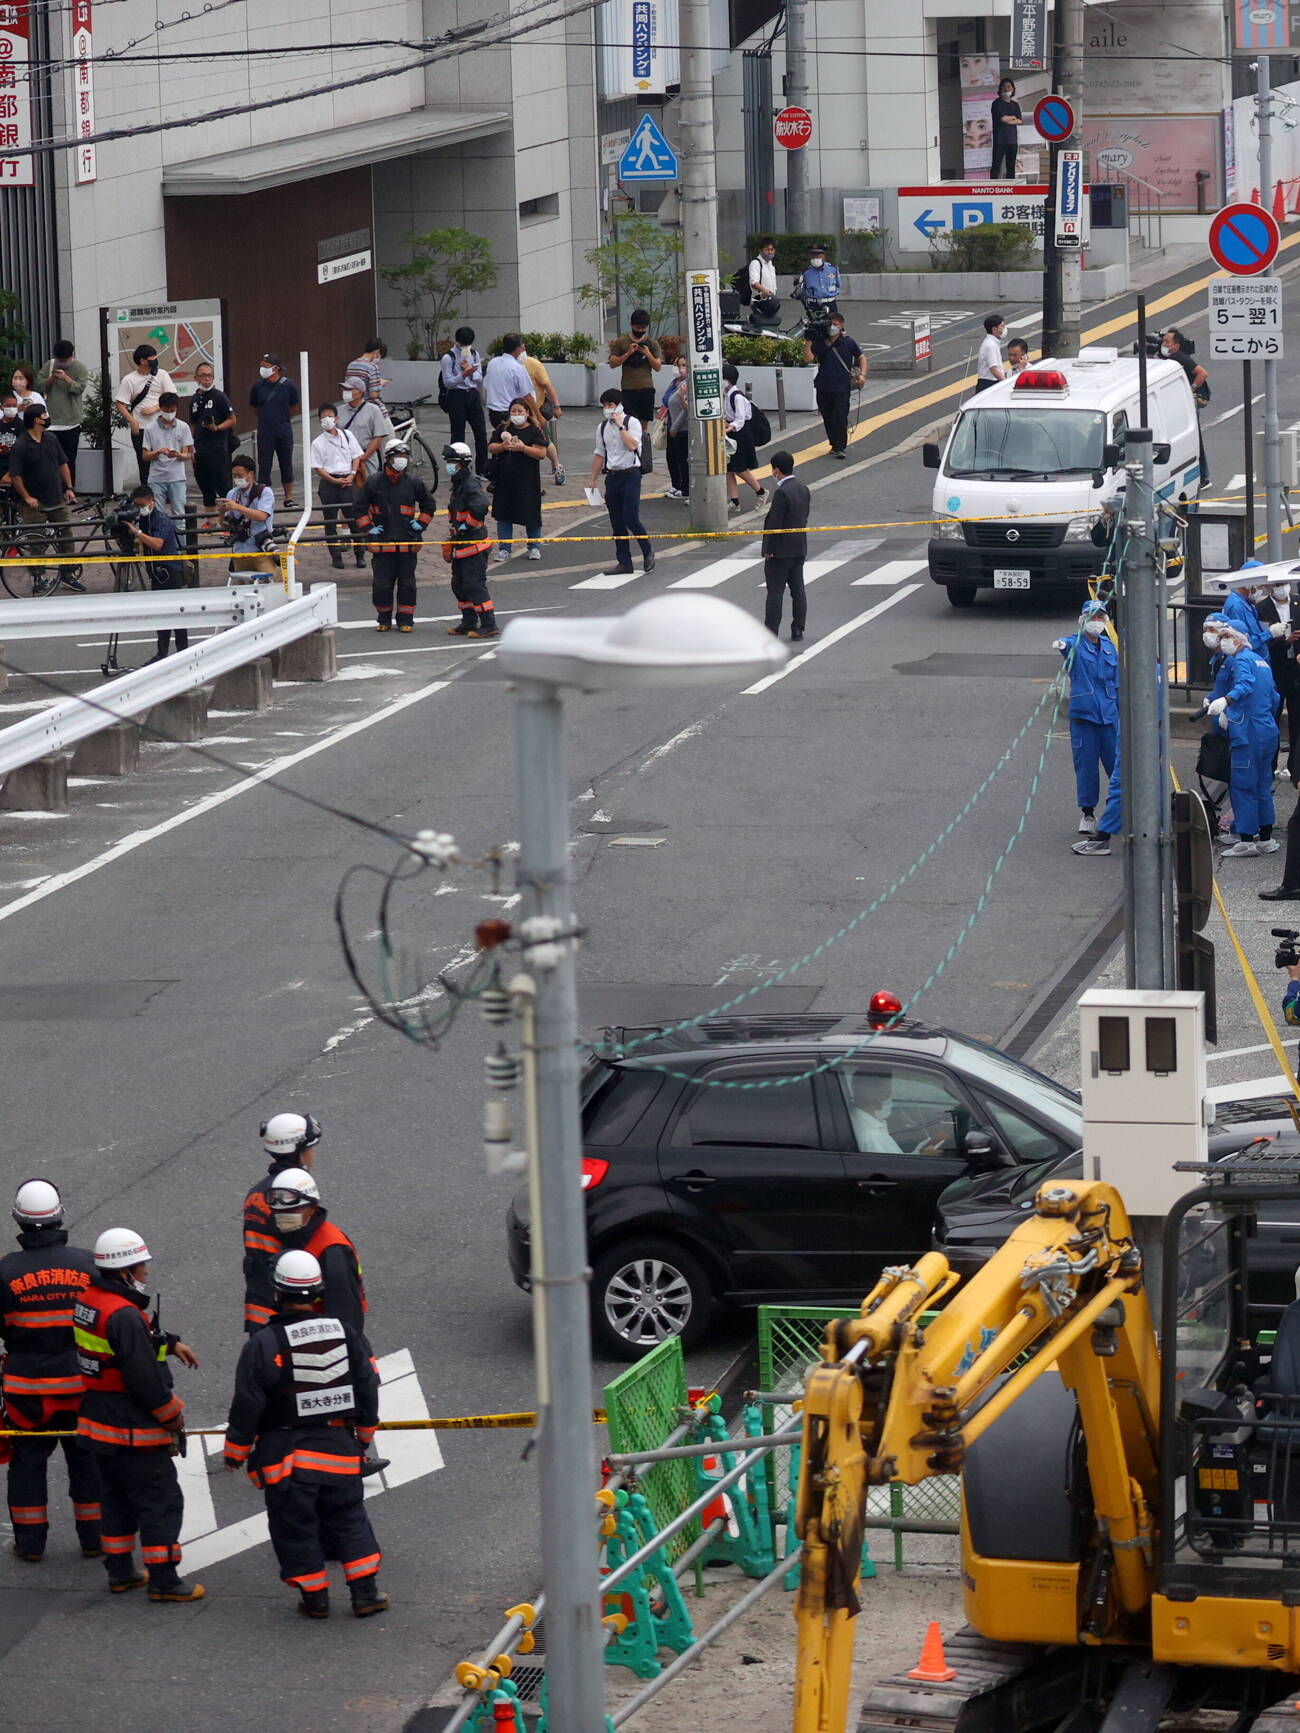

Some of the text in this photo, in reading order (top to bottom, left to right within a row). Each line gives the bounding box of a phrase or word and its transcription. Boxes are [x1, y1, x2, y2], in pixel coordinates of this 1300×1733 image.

[1022, 5, 1036, 56] 平野医院
[1090, 23, 1128, 47] aile
[776, 120, 811, 136] 防火水そう
[1101, 153, 1128, 168] mary
[1066, 162, 1076, 212] アパマンショップ
[1001, 204, 1045, 220] お客様
[1214, 338, 1279, 353] ここから
[1001, 577, 1028, 588] 58-59
[9, 1268, 92, 1295] 奈良市消防局
[20, 1292, 45, 1304] NARA
[47, 1291, 67, 1300] CITY
[291, 1323, 342, 1340] 奈良市消防局
[301, 1392, 352, 1410] 西大寺分署
